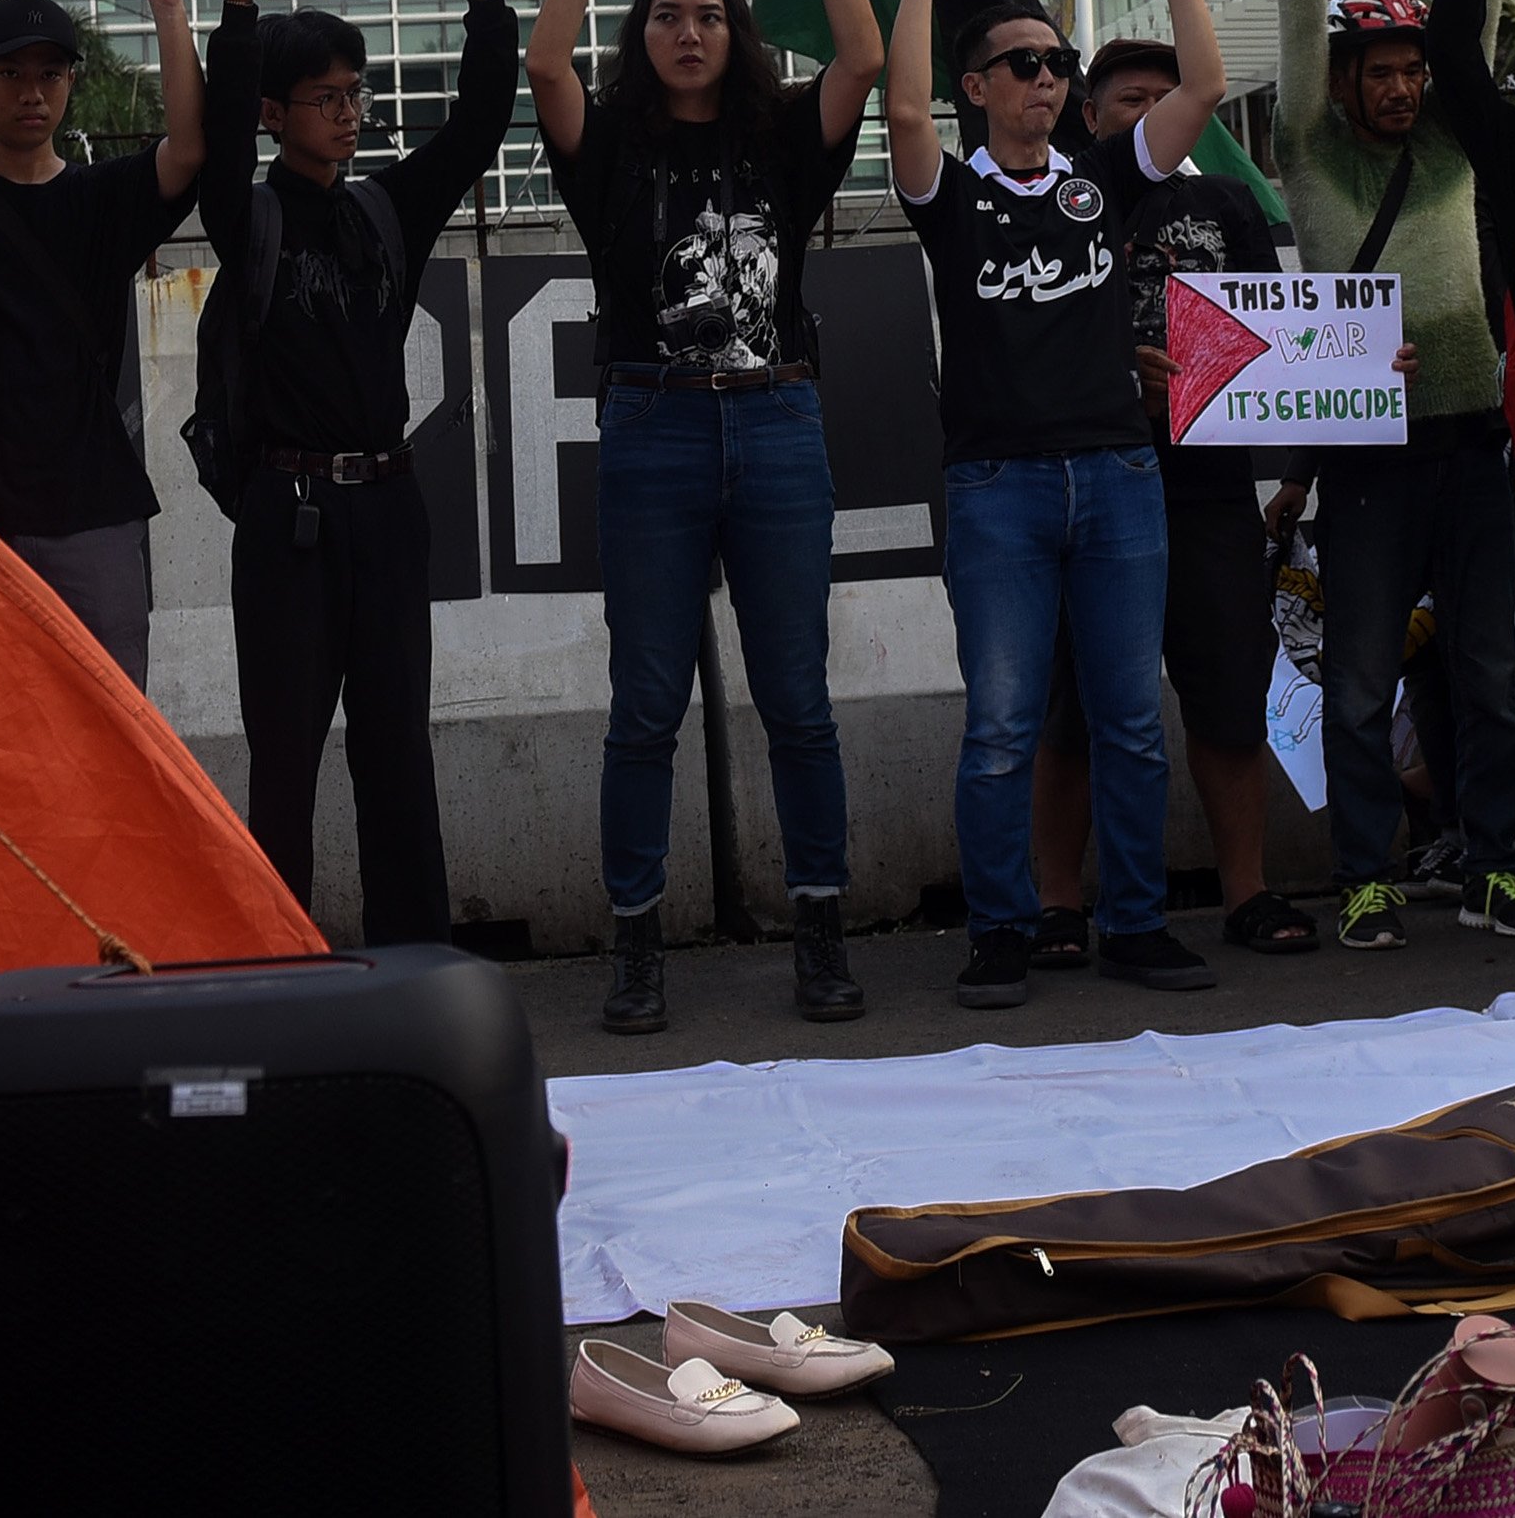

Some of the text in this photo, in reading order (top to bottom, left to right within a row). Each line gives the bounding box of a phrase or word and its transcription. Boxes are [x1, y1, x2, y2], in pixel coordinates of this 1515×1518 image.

[976, 232, 1113, 302] فلسطين
[1220, 279, 1395, 311] THIS IS NOT
[1276, 322, 1367, 363] WAR
[1228, 388, 1403, 420] IT'S GENOCIDE
